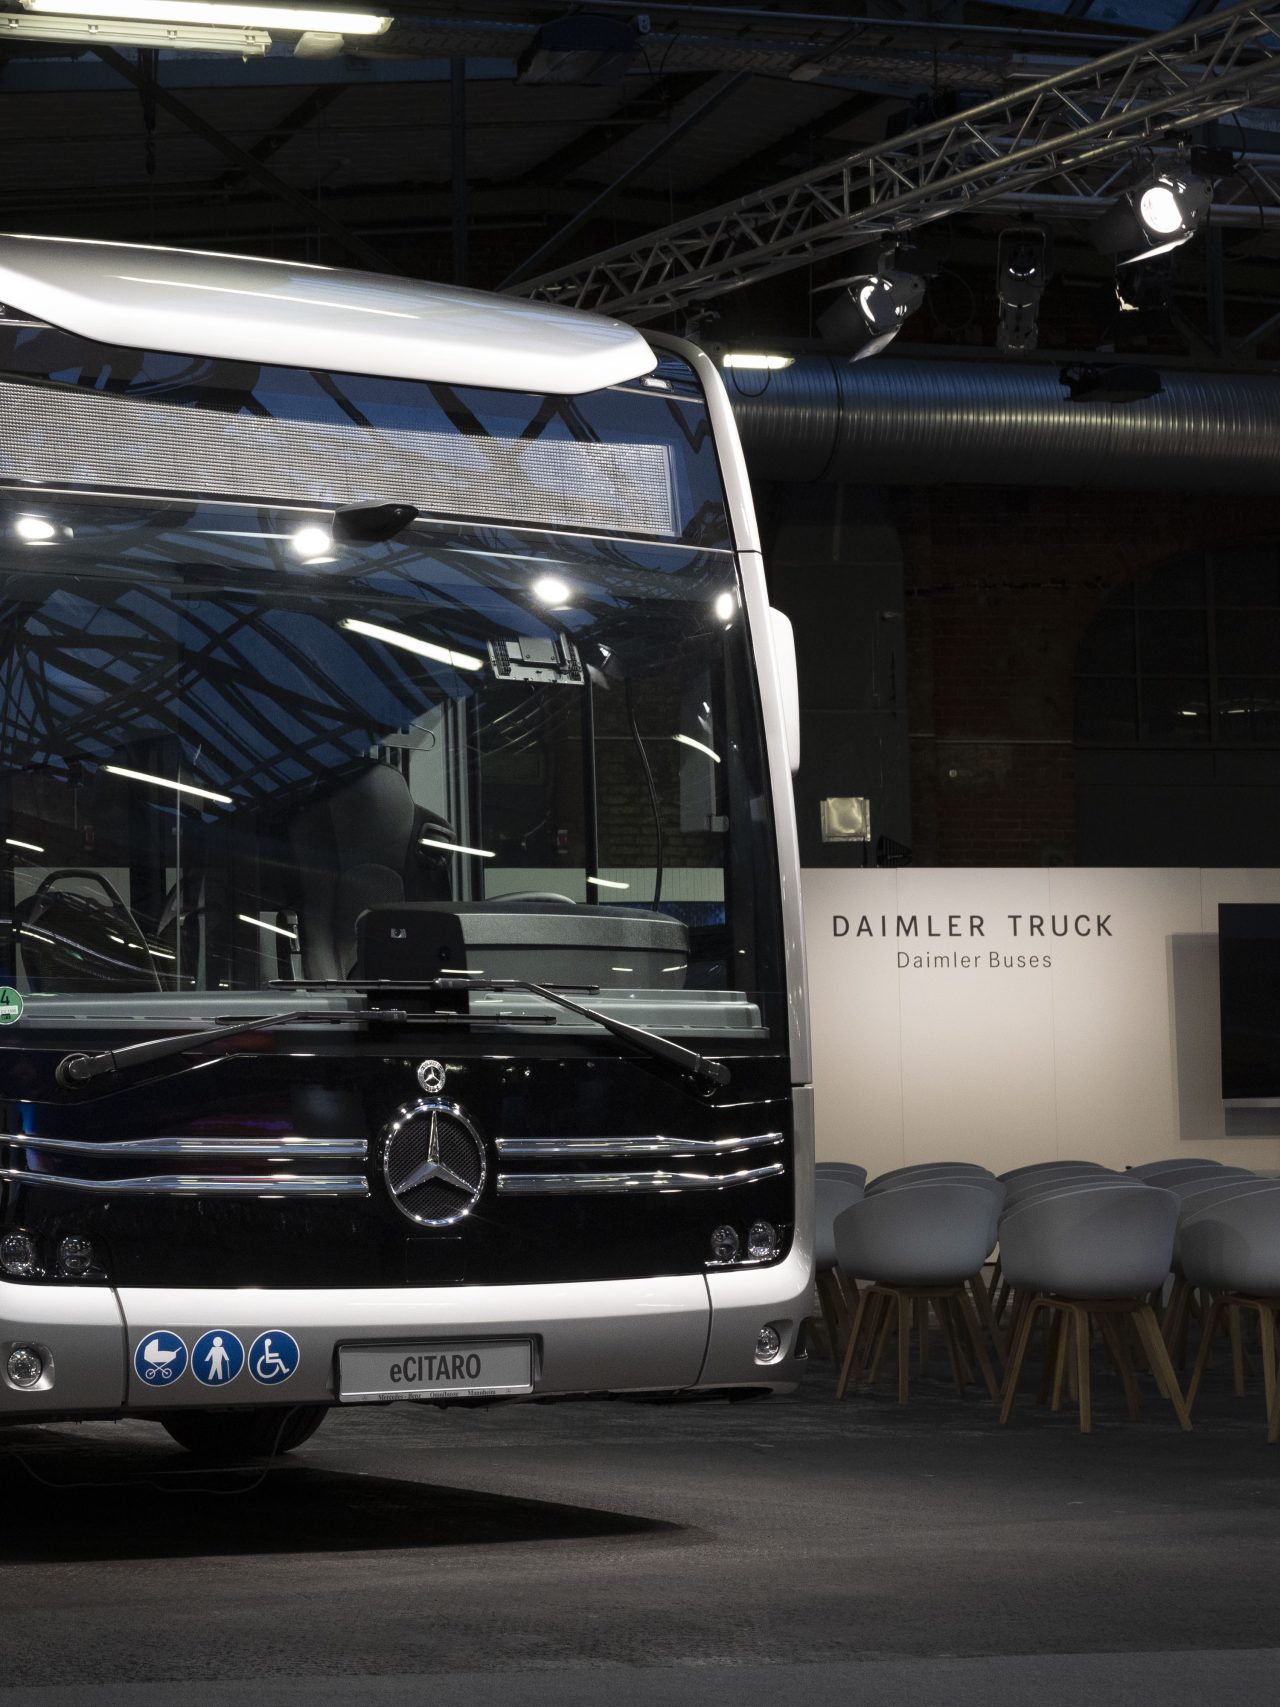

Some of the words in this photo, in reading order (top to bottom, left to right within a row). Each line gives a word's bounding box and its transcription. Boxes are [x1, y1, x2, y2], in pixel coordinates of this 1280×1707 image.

[832, 915, 986, 938] DAIMLER
[1007, 914, 1114, 938] TRUCK
[897, 951, 981, 969] Daimler
[989, 951, 1052, 969] Buses
[0, 989, 10, 1006] 4
[389, 1353, 482, 1383] eCITARO
